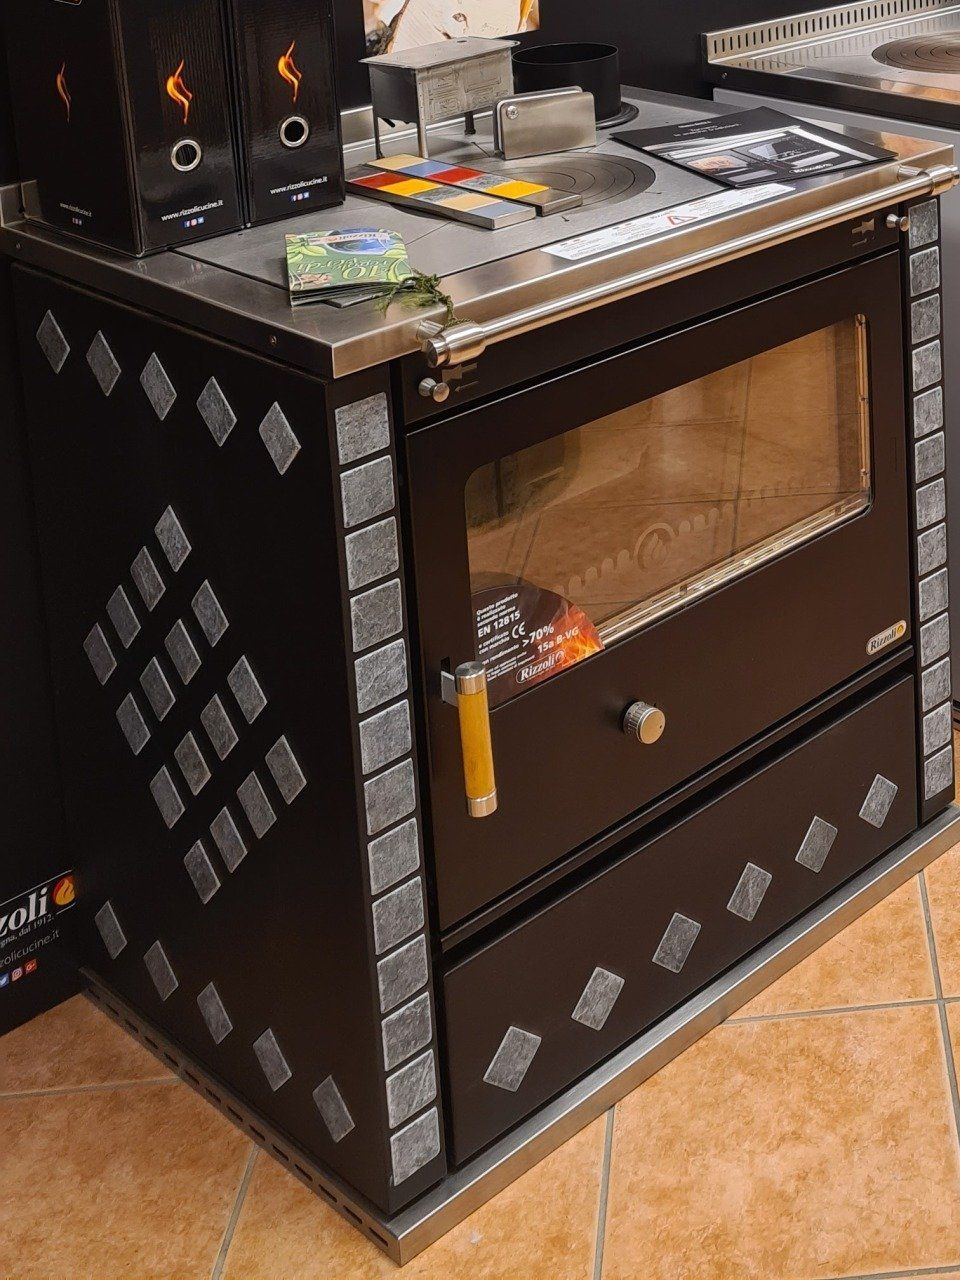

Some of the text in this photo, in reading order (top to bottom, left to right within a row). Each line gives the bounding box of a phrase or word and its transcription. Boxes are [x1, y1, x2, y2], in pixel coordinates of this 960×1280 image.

[269, 176, 328, 195] www.rizzolicucine.it
[161, 199, 224, 221] www.rizzolicucine.it
[477, 604, 495, 616] Questo
[477, 610, 521, 638] EN 12815
[537, 625, 580, 654] 15a B-VG
[870, 628, 897, 652] Rizzoli
[520, 653, 556, 681] Rizzoli
